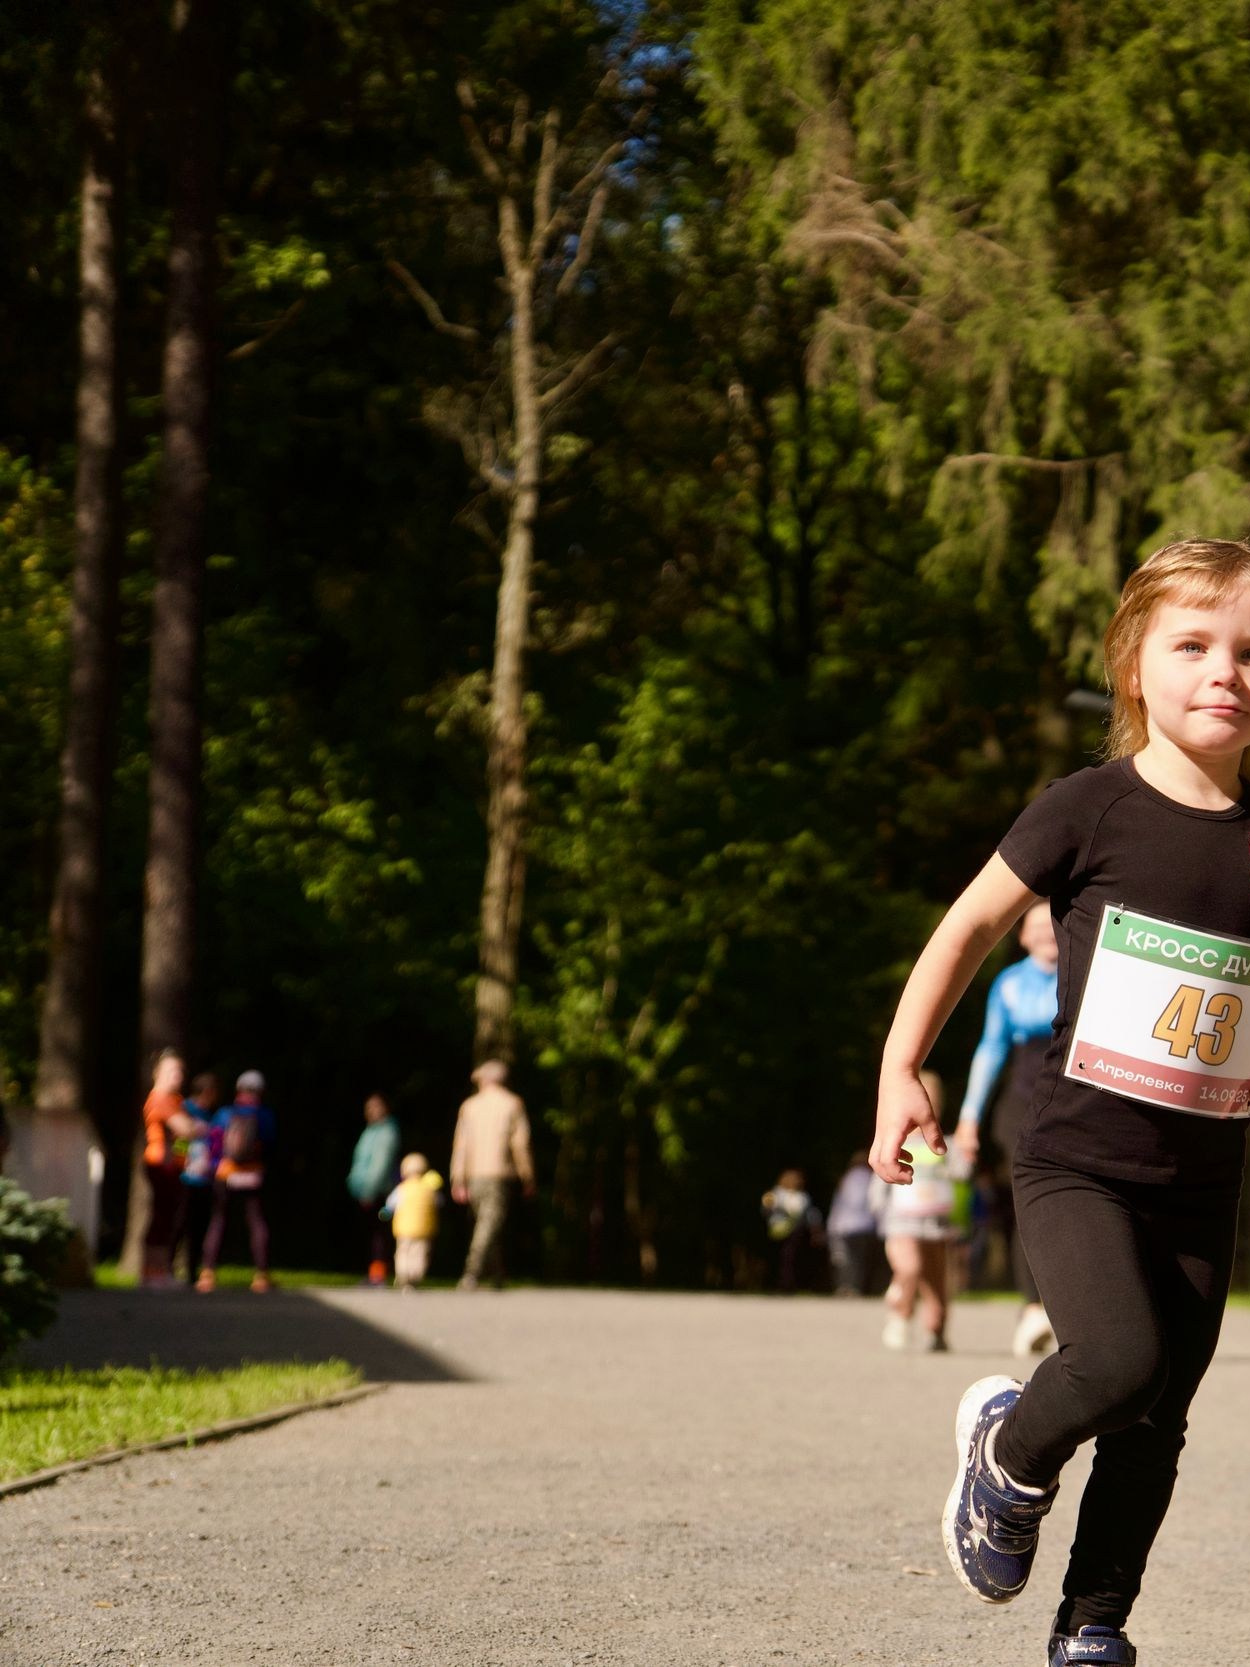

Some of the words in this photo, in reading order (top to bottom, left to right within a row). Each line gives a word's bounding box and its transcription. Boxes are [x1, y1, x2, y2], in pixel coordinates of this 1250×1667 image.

[1125, 927, 1219, 969] КРОСС
[1152, 984, 1243, 1066] 43
[1092, 1058, 1185, 1094] Апрелевка
